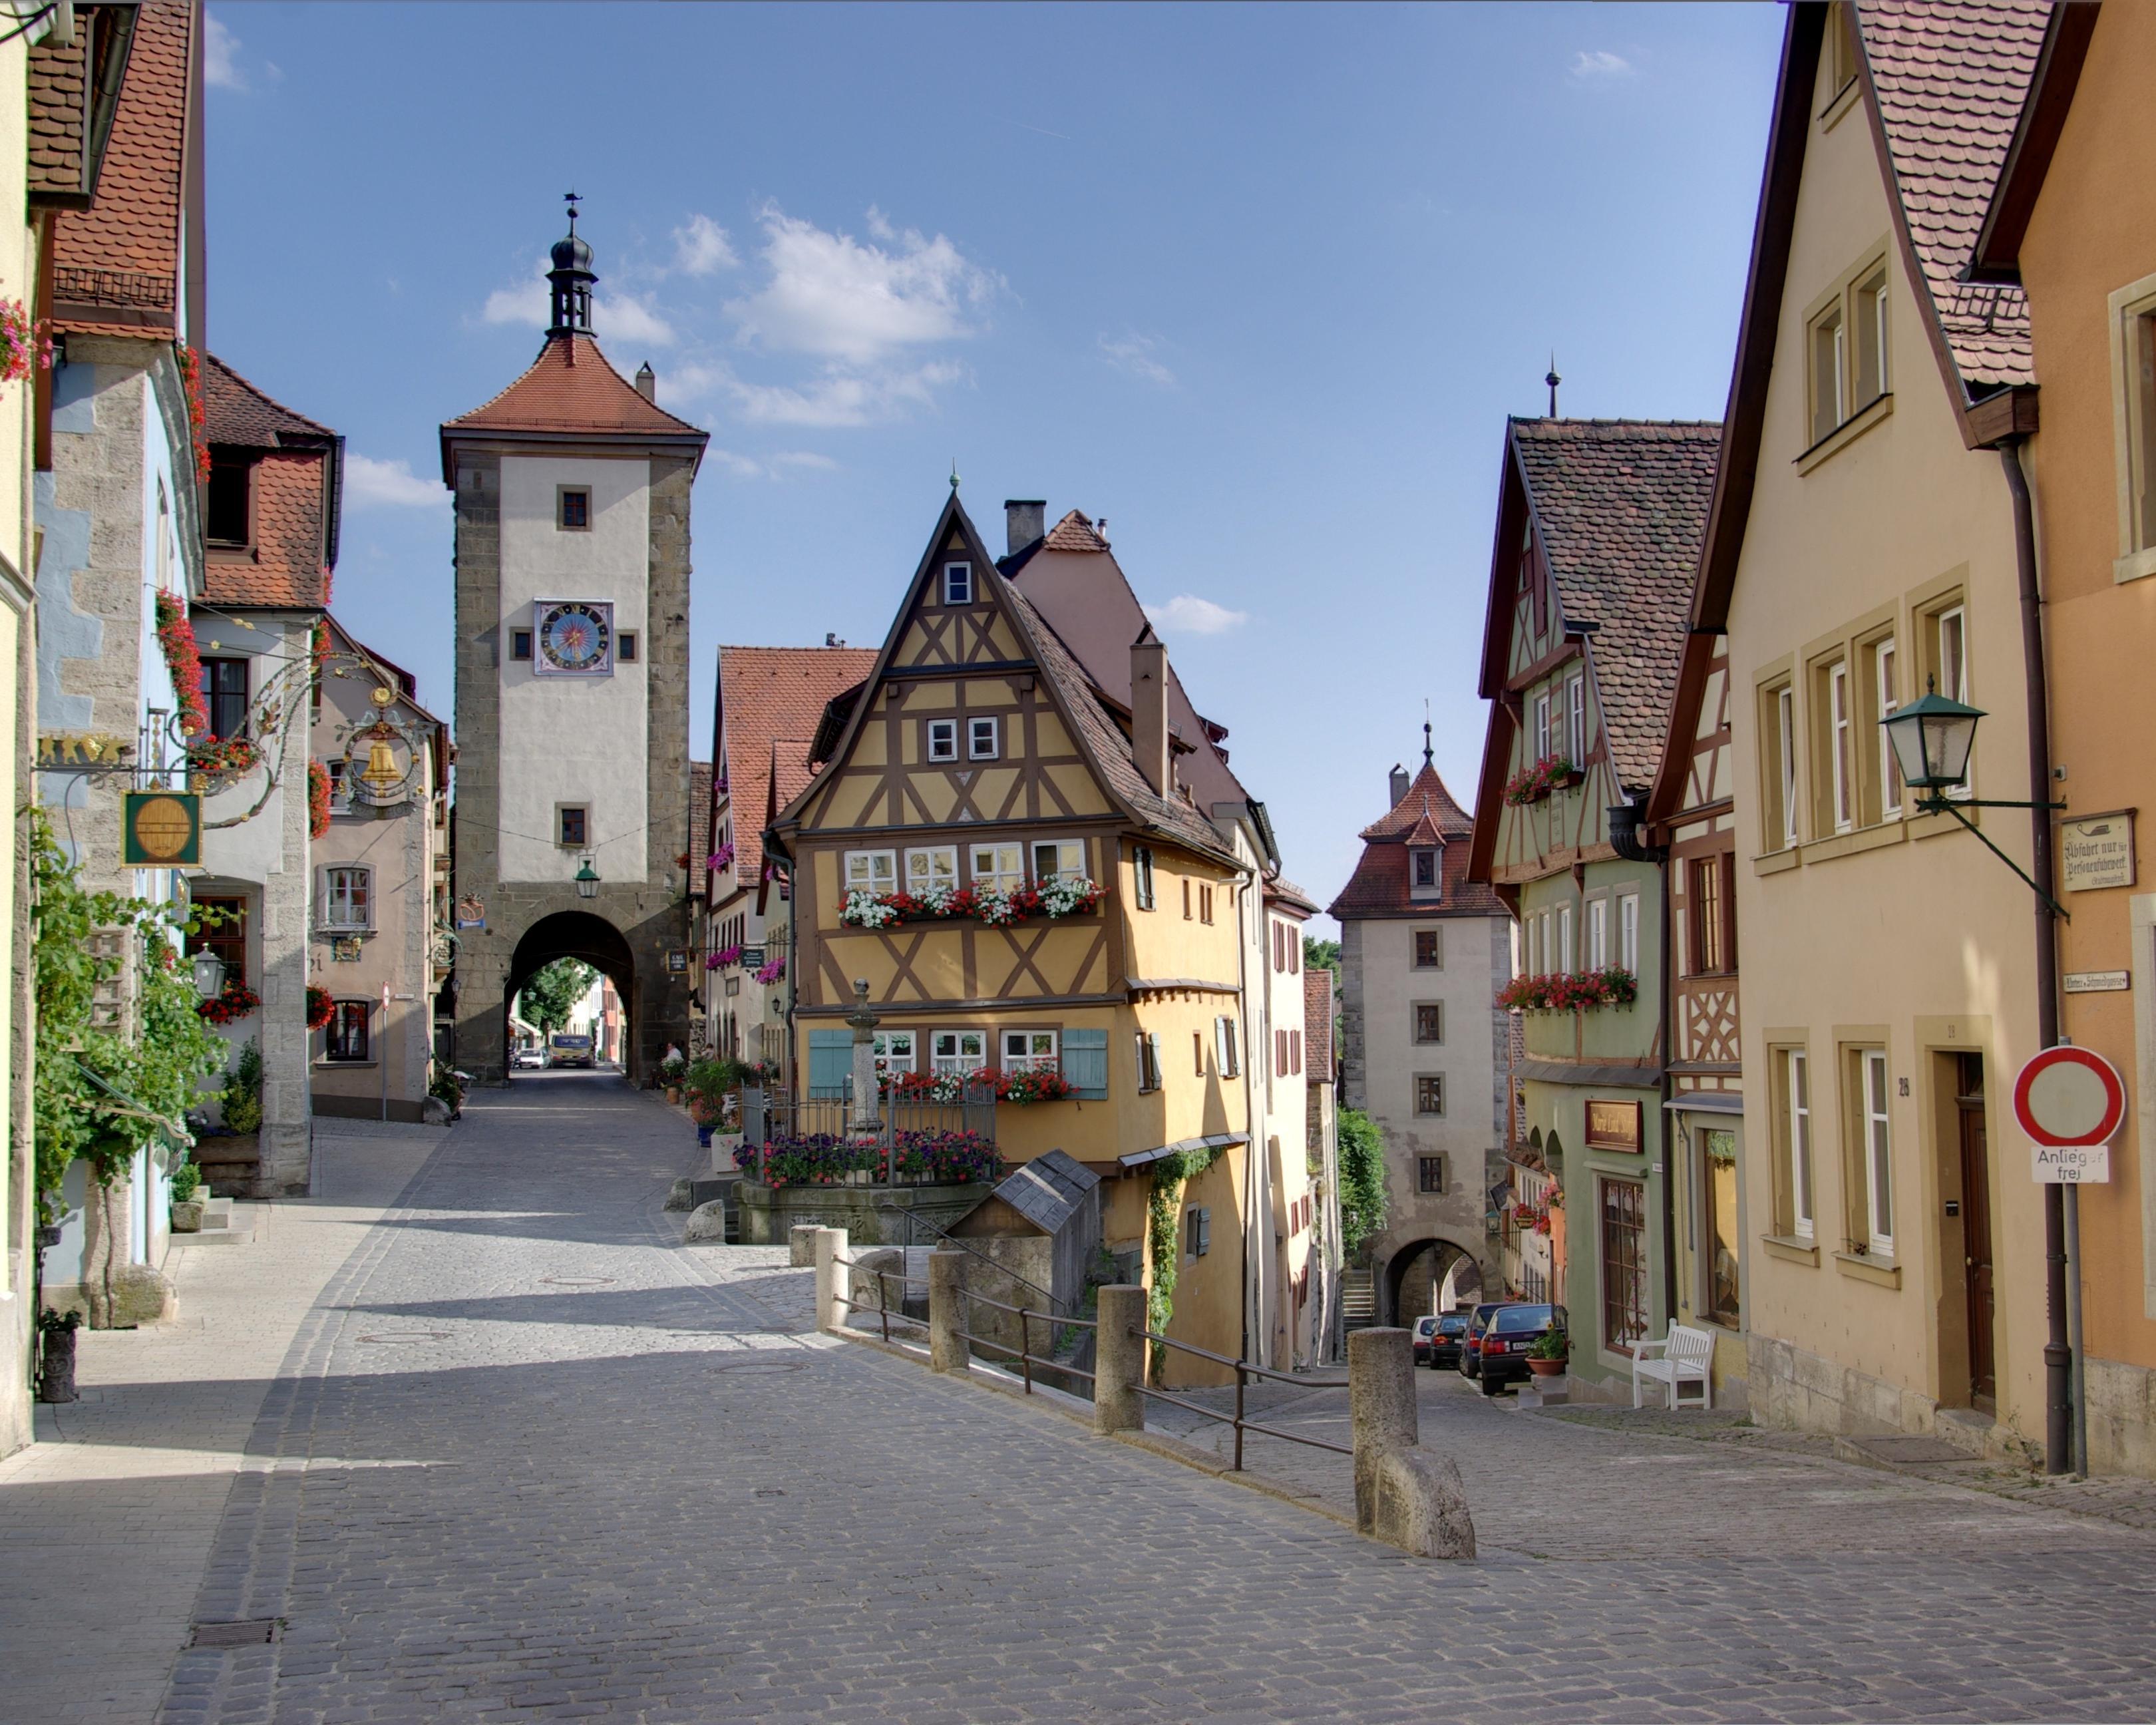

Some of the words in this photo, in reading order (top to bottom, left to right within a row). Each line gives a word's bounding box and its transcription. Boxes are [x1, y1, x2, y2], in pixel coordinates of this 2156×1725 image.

[2065, 842, 2099, 861] Abfahrt
[2101, 842, 2117, 854] nur
[2118, 842, 2127, 853] für
[1898, 1077, 1910, 1097] 28
[2038, 1149, 2103, 1167] Anliegr
